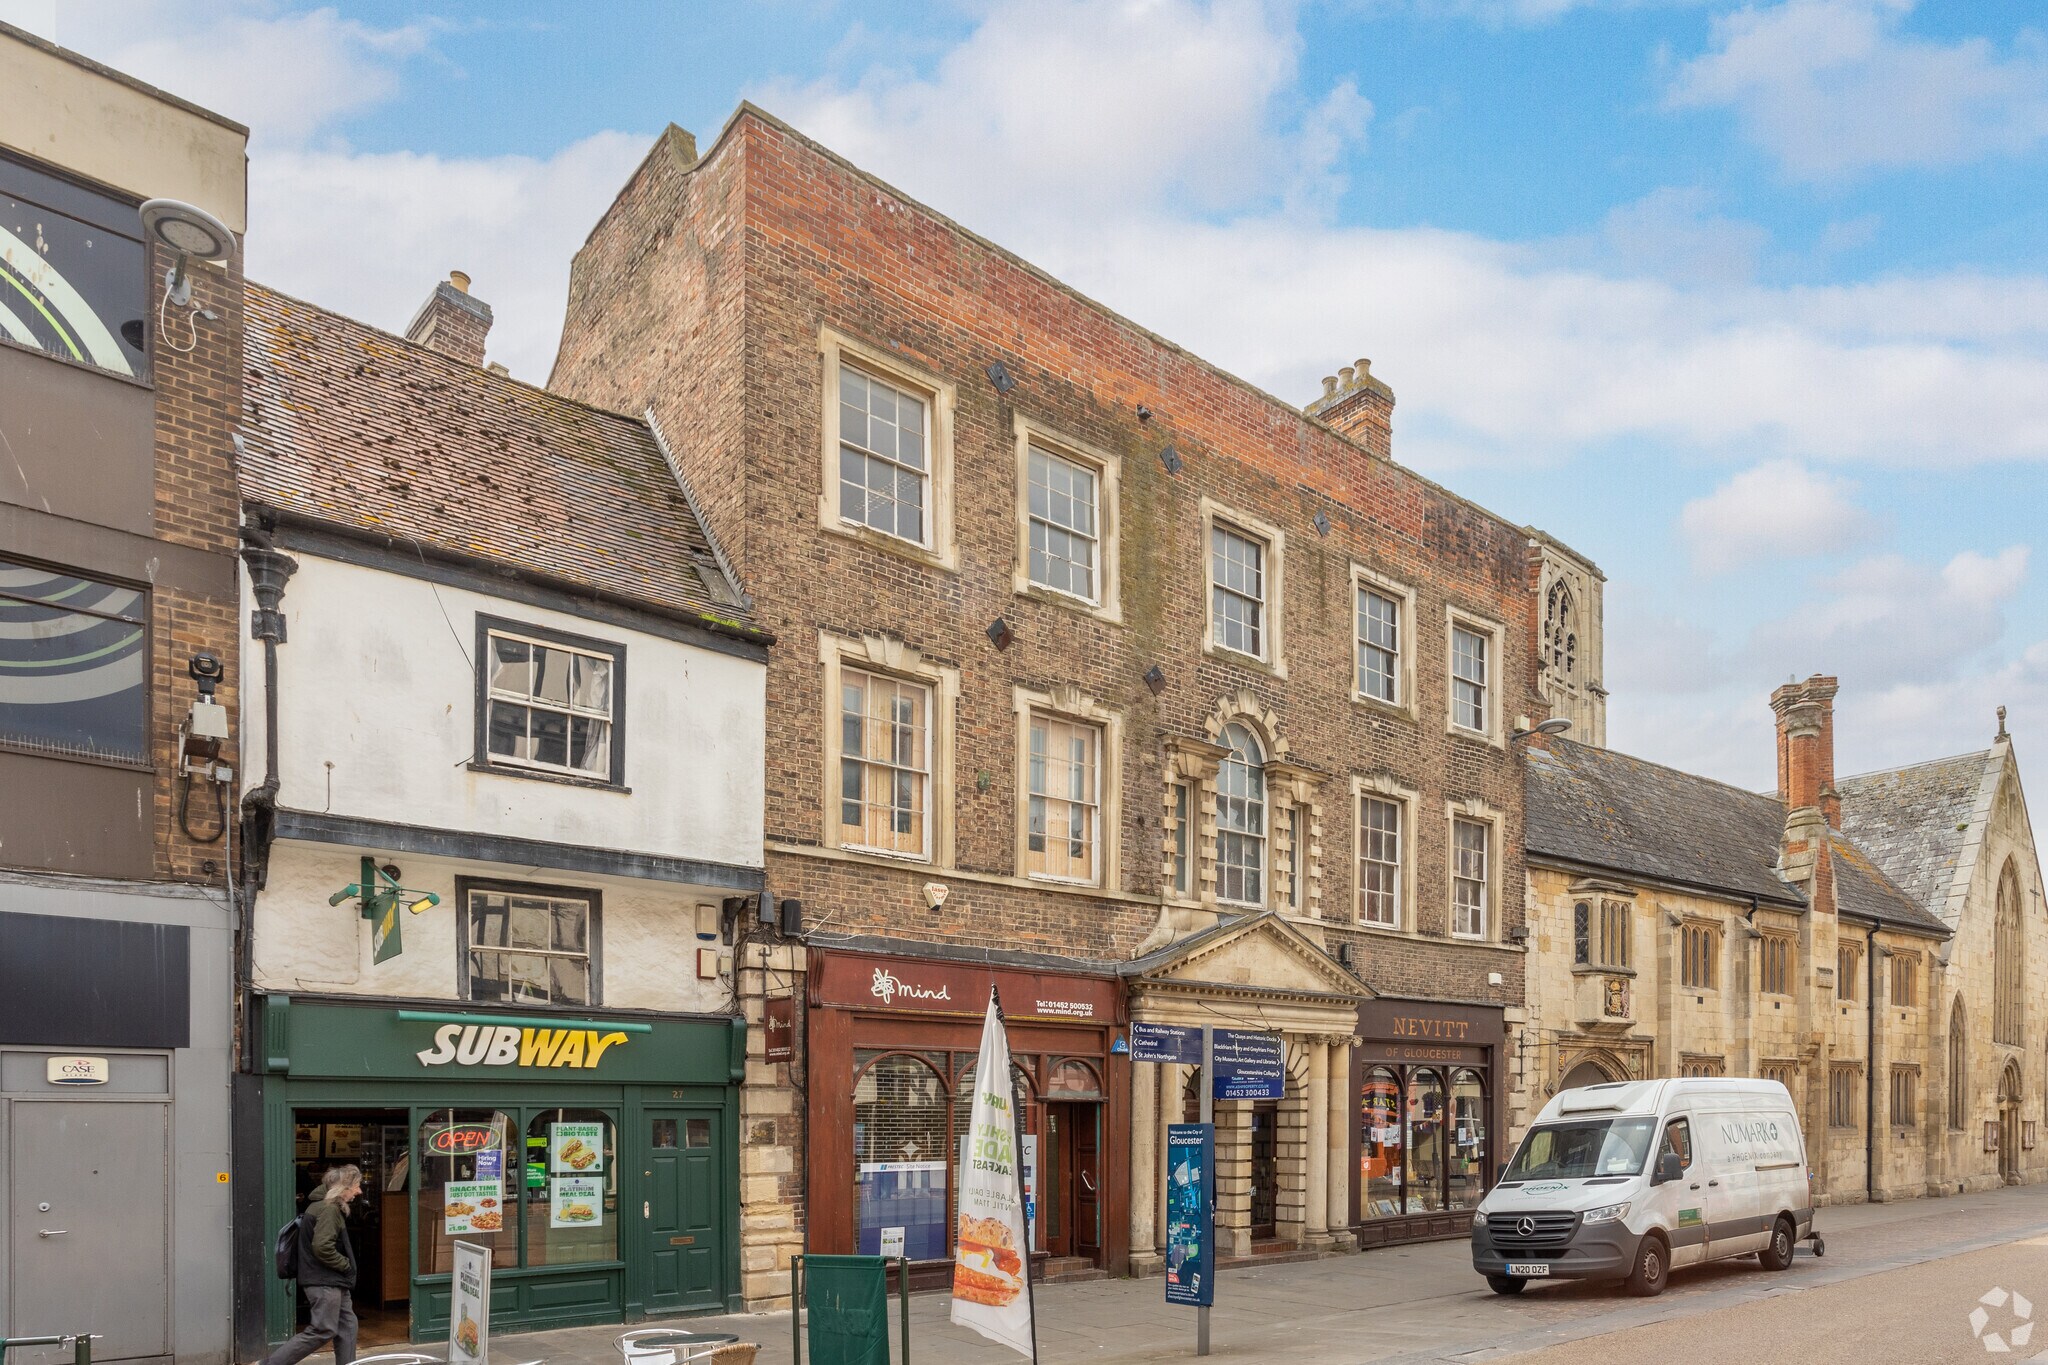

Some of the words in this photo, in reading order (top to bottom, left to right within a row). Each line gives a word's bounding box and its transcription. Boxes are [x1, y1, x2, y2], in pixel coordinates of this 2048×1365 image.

[374, 900, 397, 958] SUBWAY
[896, 976, 951, 1000] mind
[1069, 1002, 1093, 1010] 500532
[1037, 1008, 1093, 1017] www.mind.org.uk
[1155, 1027, 1170, 1036] Railway
[1393, 1017, 1469, 1039] NEVITT
[1235, 1033, 1246, 1041] Quays
[416, 1024, 629, 1068] SUBWAY
[1266, 1047, 1277, 1055] Friary
[1386, 1047, 1399, 1057] OF
[1404, 1048, 1462, 1060] GLOUCESTER
[1157, 1053, 1177, 1061] Northgate
[1214, 1055, 1222, 1063] City
[62, 1064, 96, 1073] CASE
[1263, 1070, 1277, 1078] College
[672, 1090, 684, 1099] 27
[1225, 1089, 1244, 1097] 01452
[1245, 1089, 1270, 1097] 300433
[1721, 1122, 1771, 1144] NUMARK
[437, 1131, 491, 1148] OPEN
[1169, 1135, 1203, 1145] Gloucester
[1732, 1152, 1759, 1162] PHOENIX
[1760, 1152, 1783, 1160] company
[915, 1161, 931, 1169] Notice
[219, 1174, 227, 1182] 6
[1521, 1184, 1569, 1192] PHOENIX
[1510, 1266, 1531, 1274] LN20
[1532, 1265, 1548, 1273] OZF
[460, 1271, 480, 1289] PLATINUM
